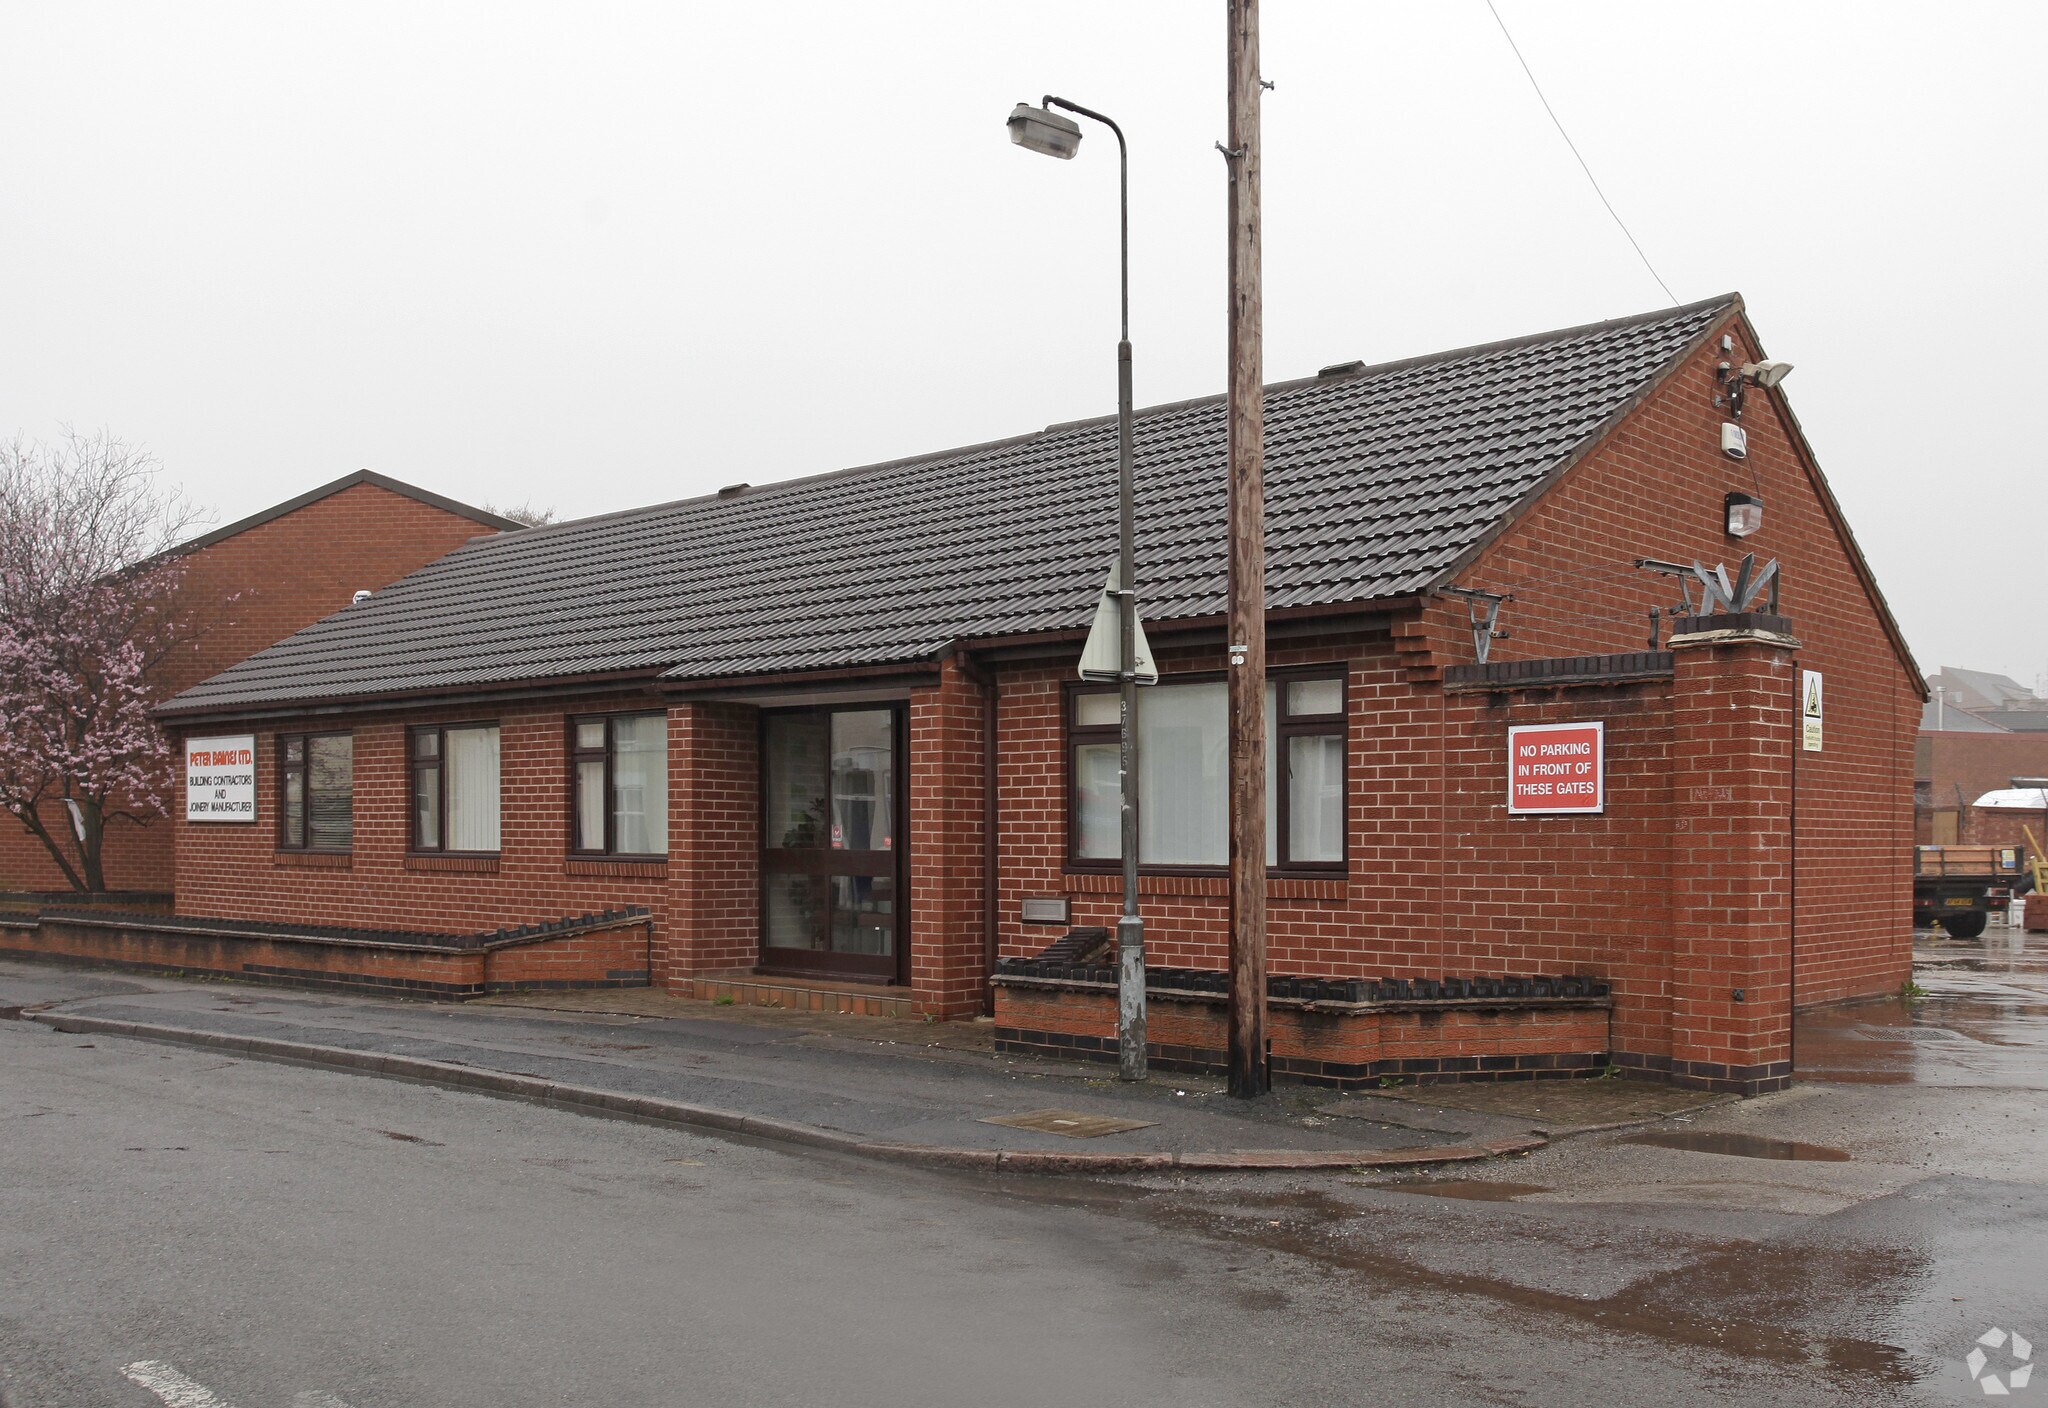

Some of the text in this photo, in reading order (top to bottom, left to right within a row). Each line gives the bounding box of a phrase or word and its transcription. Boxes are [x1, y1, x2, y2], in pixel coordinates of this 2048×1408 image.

[1520, 743, 1590, 757] NO PARKING
[190, 751, 211, 767] PETER
[1518, 762, 1592, 776] IN FRONT OF
[190, 775, 252, 787] BUILDING CONTRACTORS
[1516, 781, 1594, 795] THESE GATES
[214, 789, 227, 799] AND
[190, 801, 252, 812] JOINERY MANUFACTURER
